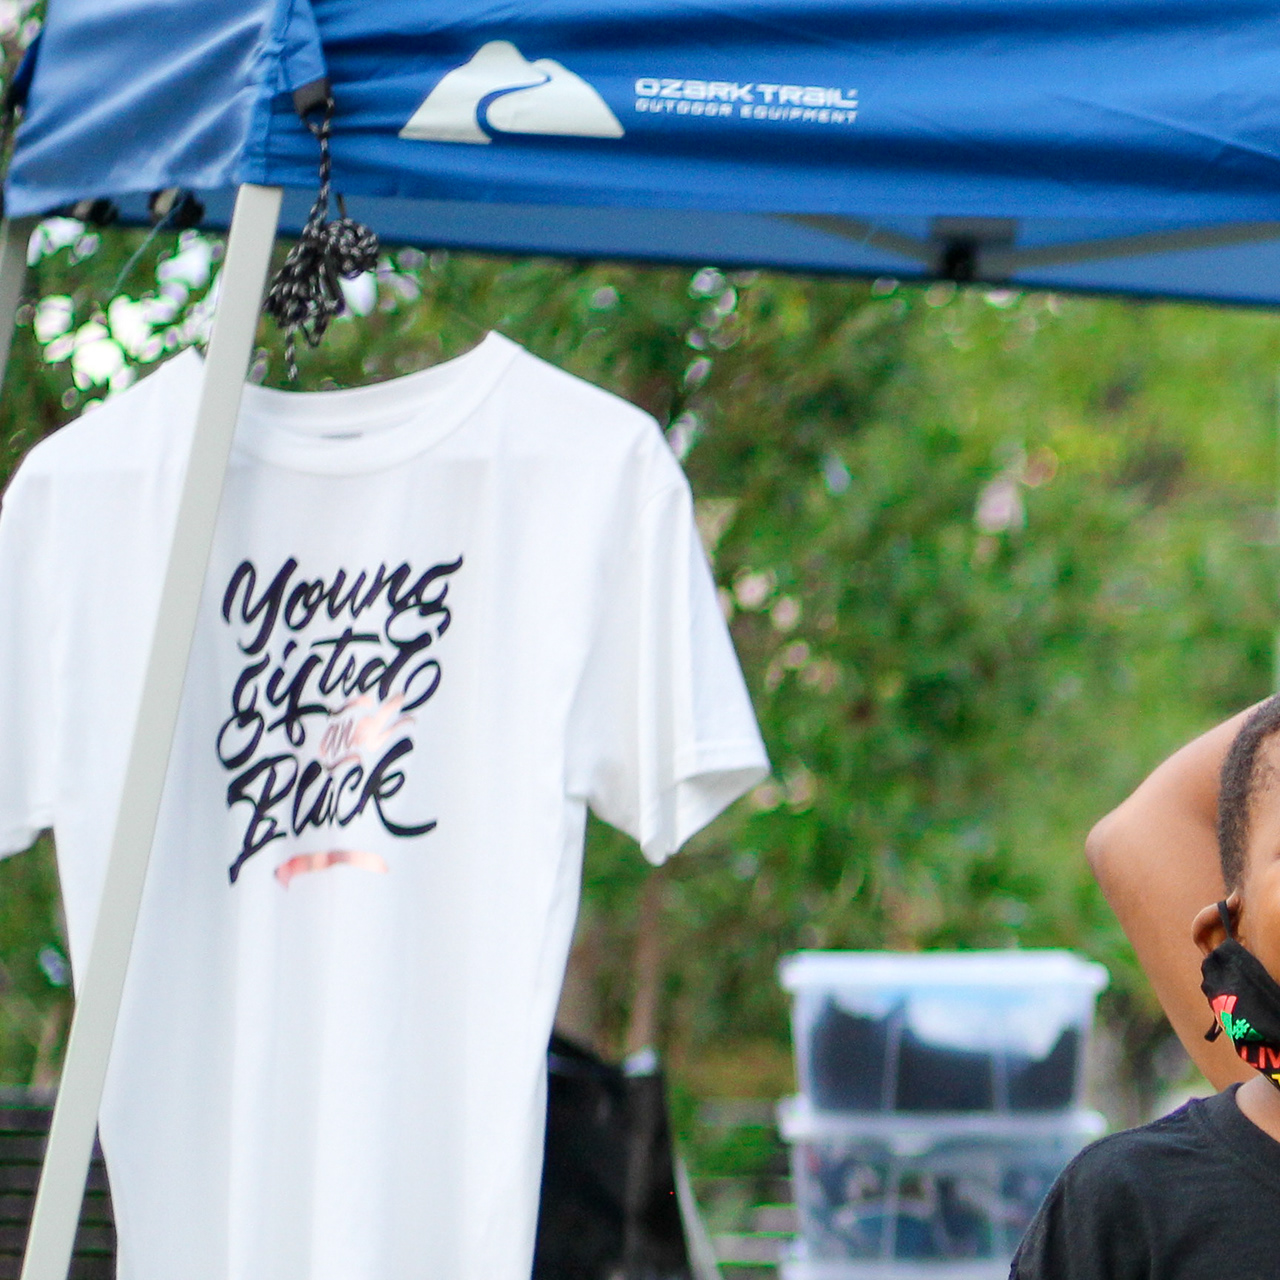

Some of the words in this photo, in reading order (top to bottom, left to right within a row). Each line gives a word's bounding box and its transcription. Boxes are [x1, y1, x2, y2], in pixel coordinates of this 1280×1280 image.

[634, 77, 755, 102] OZARK
[756, 83, 858, 109] TRAIL
[635, 98, 733, 117] OUTDOOR
[739, 103, 858, 124] EQUIPMENT
[222, 554, 463, 656] Young
[228, 737, 438, 883] Black
